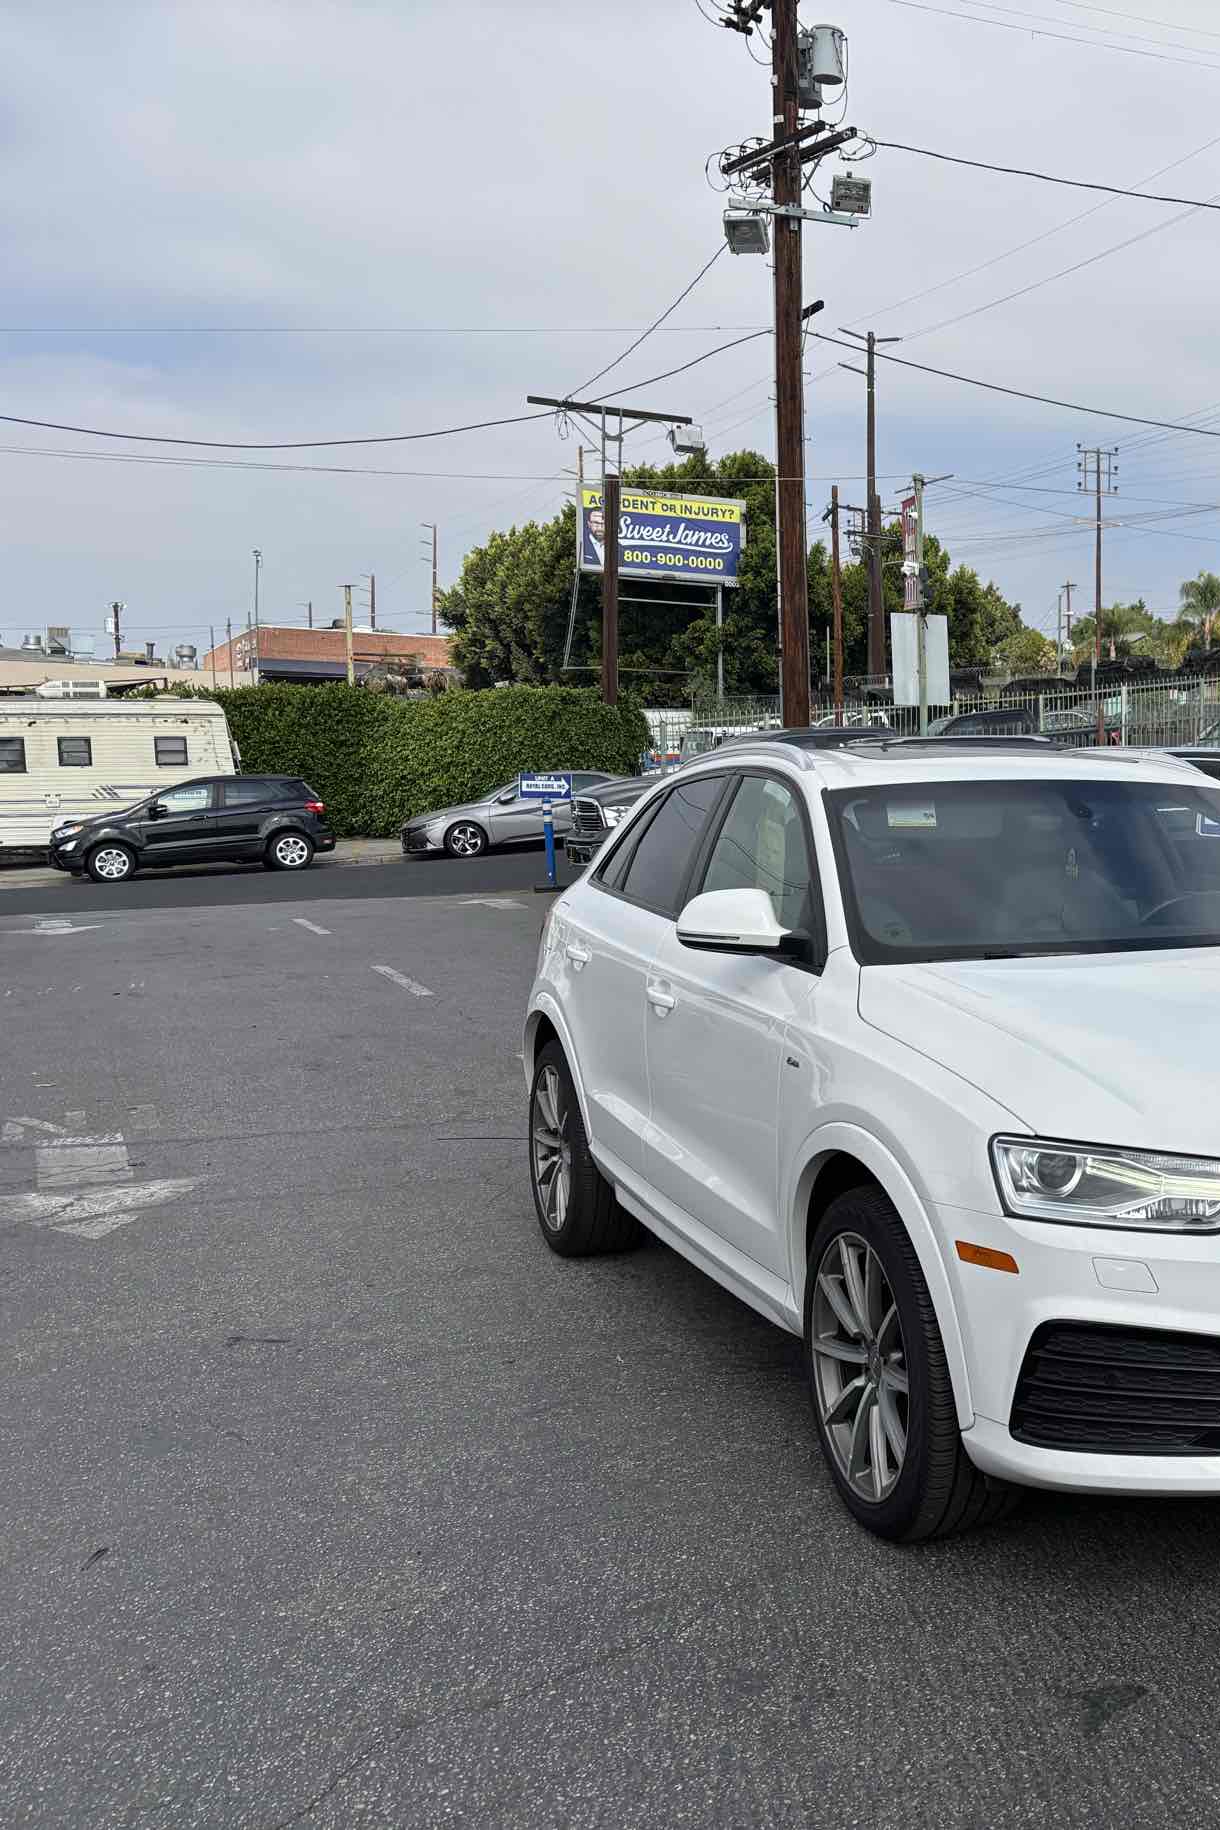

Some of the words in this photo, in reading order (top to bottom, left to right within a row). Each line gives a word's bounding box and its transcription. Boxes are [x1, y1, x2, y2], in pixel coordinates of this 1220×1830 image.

[589, 494, 657, 513] ACDENT
[661, 502, 677, 514] OR
[680, 505, 735, 520] INJURY?
[623, 550, 724, 570] 800-900-0000
